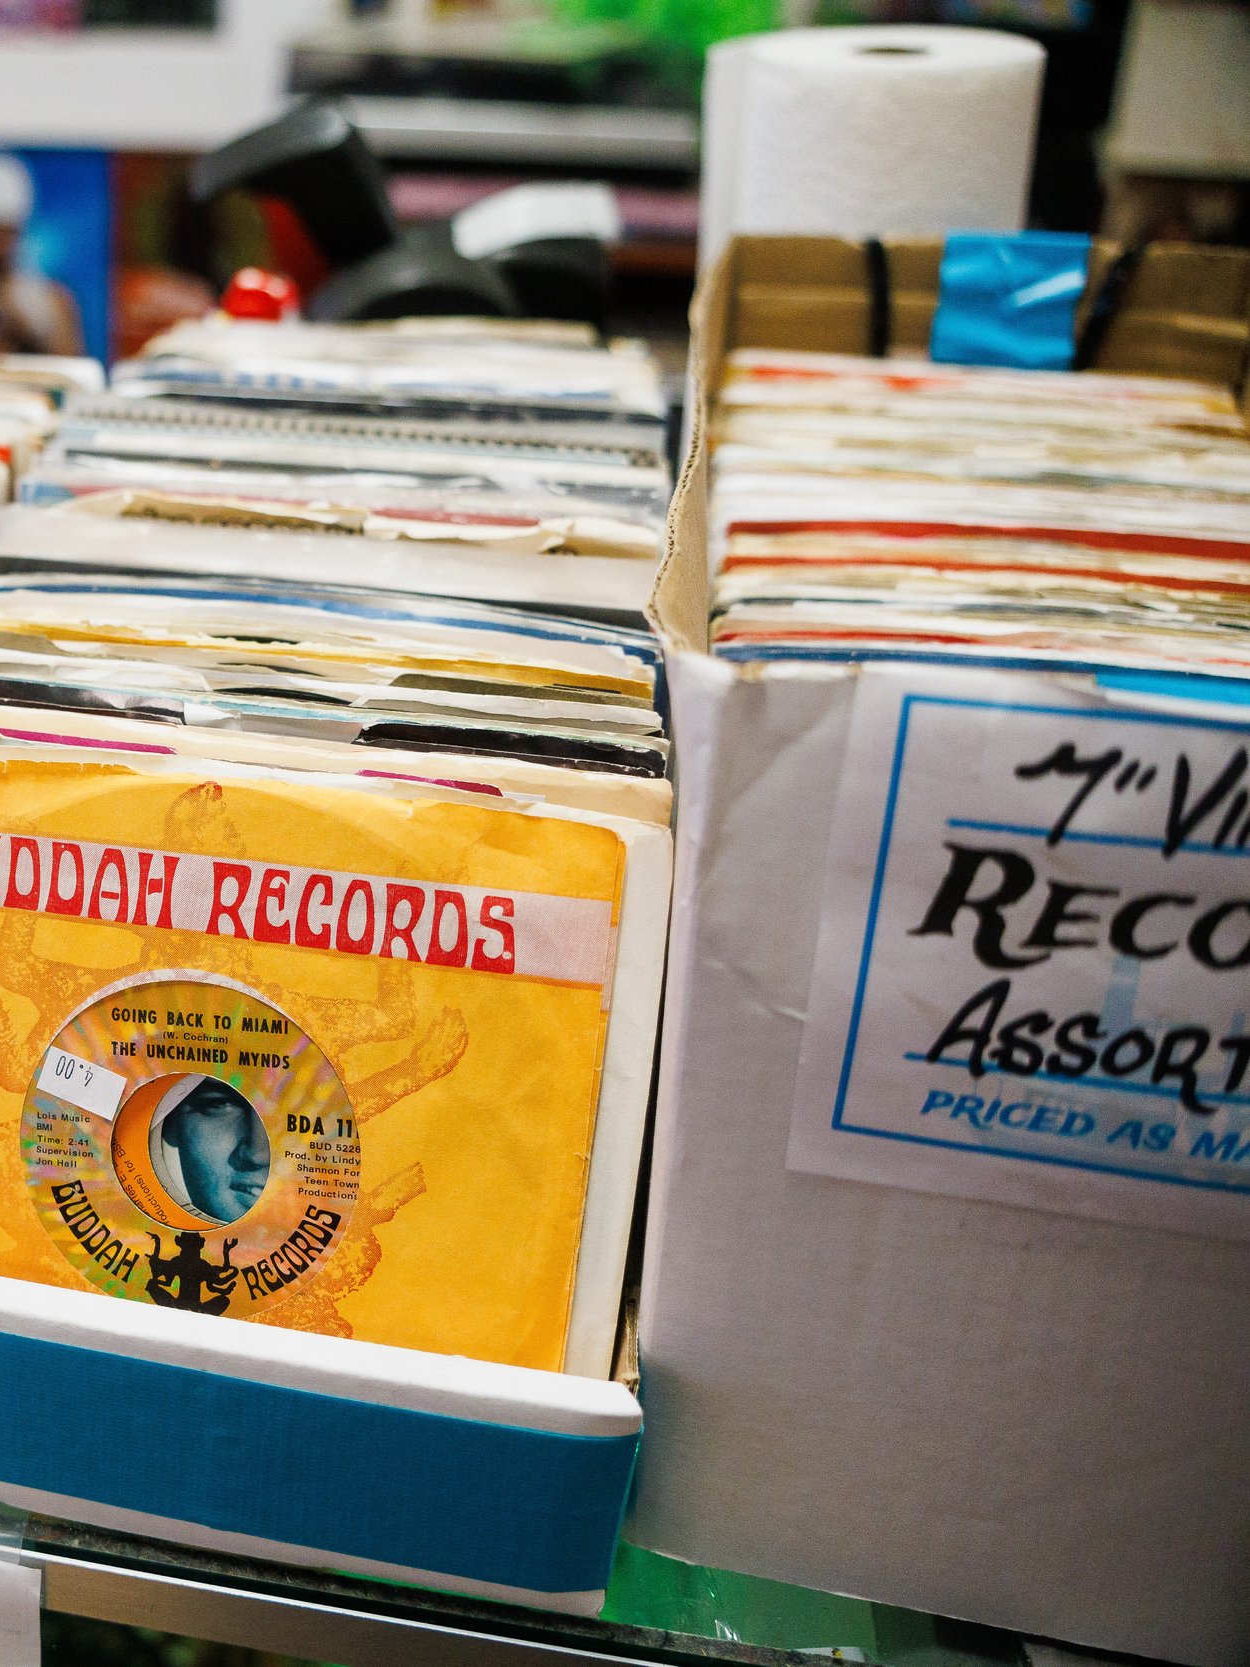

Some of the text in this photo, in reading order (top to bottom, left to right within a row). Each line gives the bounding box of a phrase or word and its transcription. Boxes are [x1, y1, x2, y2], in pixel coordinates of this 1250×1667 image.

[205, 861, 516, 975] RECORDS
[111, 1007, 289, 1035] GOING BACK TO MIAMI
[162, 1031, 229, 1044] (W. Cochran)
[111, 1041, 290, 1070] THE UNCHAINED MYNDS
[37, 1111, 91, 1123] Lois Music
[919, 1088, 1096, 1138] PRICED
[1107, 1120, 1177, 1152] AS
[36, 1122, 53, 1132] BMI
[287, 1113, 324, 1135] BDA
[37, 1135, 89, 1147] Time: 2:41
[309, 1141, 332, 1151] BUD
[36, 1146, 94, 1158] Supervision
[285, 1150, 361, 1166] Prod. by Lindy
[35, 1157, 77, 1168] Jon Hall
[296, 1164, 360, 1177] Shannon For
[304, 1176, 360, 1188] Teen Town
[134, 1174, 170, 1225] roductions)
[50, 1179, 342, 1300] BUDDAH RECORDS
